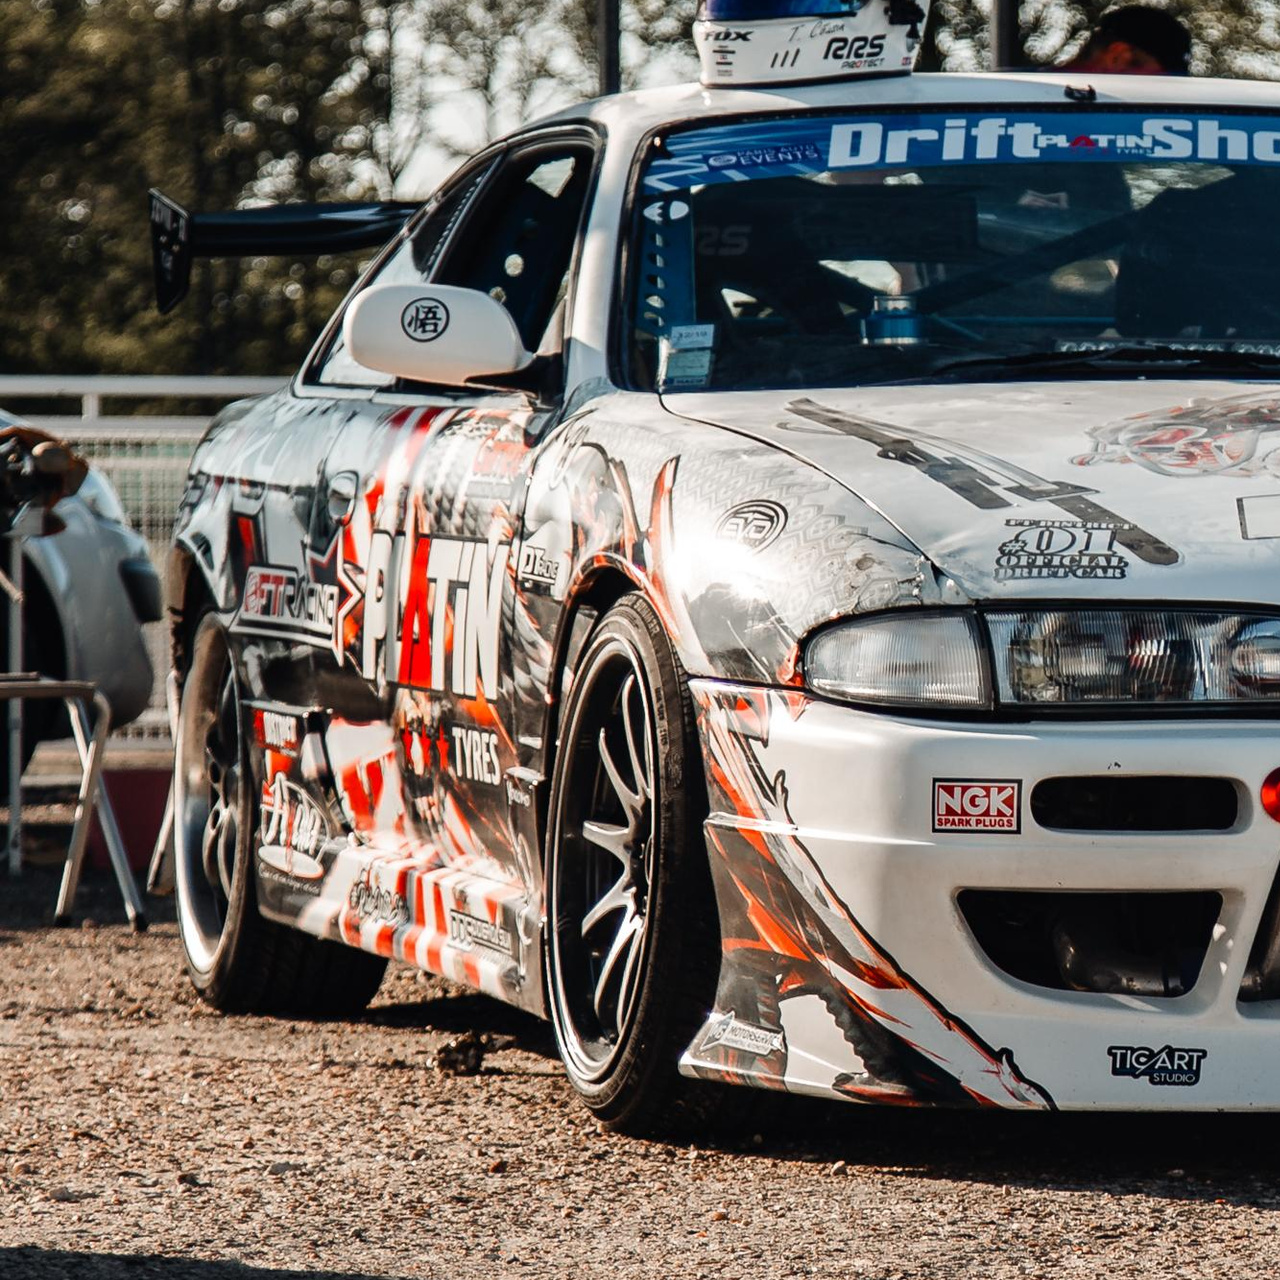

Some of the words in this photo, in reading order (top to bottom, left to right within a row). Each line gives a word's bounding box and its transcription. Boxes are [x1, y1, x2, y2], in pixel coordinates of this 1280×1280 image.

[823, 34, 887, 60] RRS
[828, 118, 1041, 167] Drift
[1037, 133, 1154, 149] PLATIN
[740, 151, 819, 166] EVENTS
[998, 554, 1127, 568] OFFICIAL
[997, 567, 1070, 580] DRIFT
[1074, 567, 1123, 579] CAR
[363, 531, 510, 702] PLATIN
[452, 725, 501, 787] TYRES
[939, 786, 1014, 817] NGK
[937, 817, 973, 828] SPARK
[975, 818, 1014, 828] PLUGS
[1152, 1072, 1196, 1083] STUDIO
